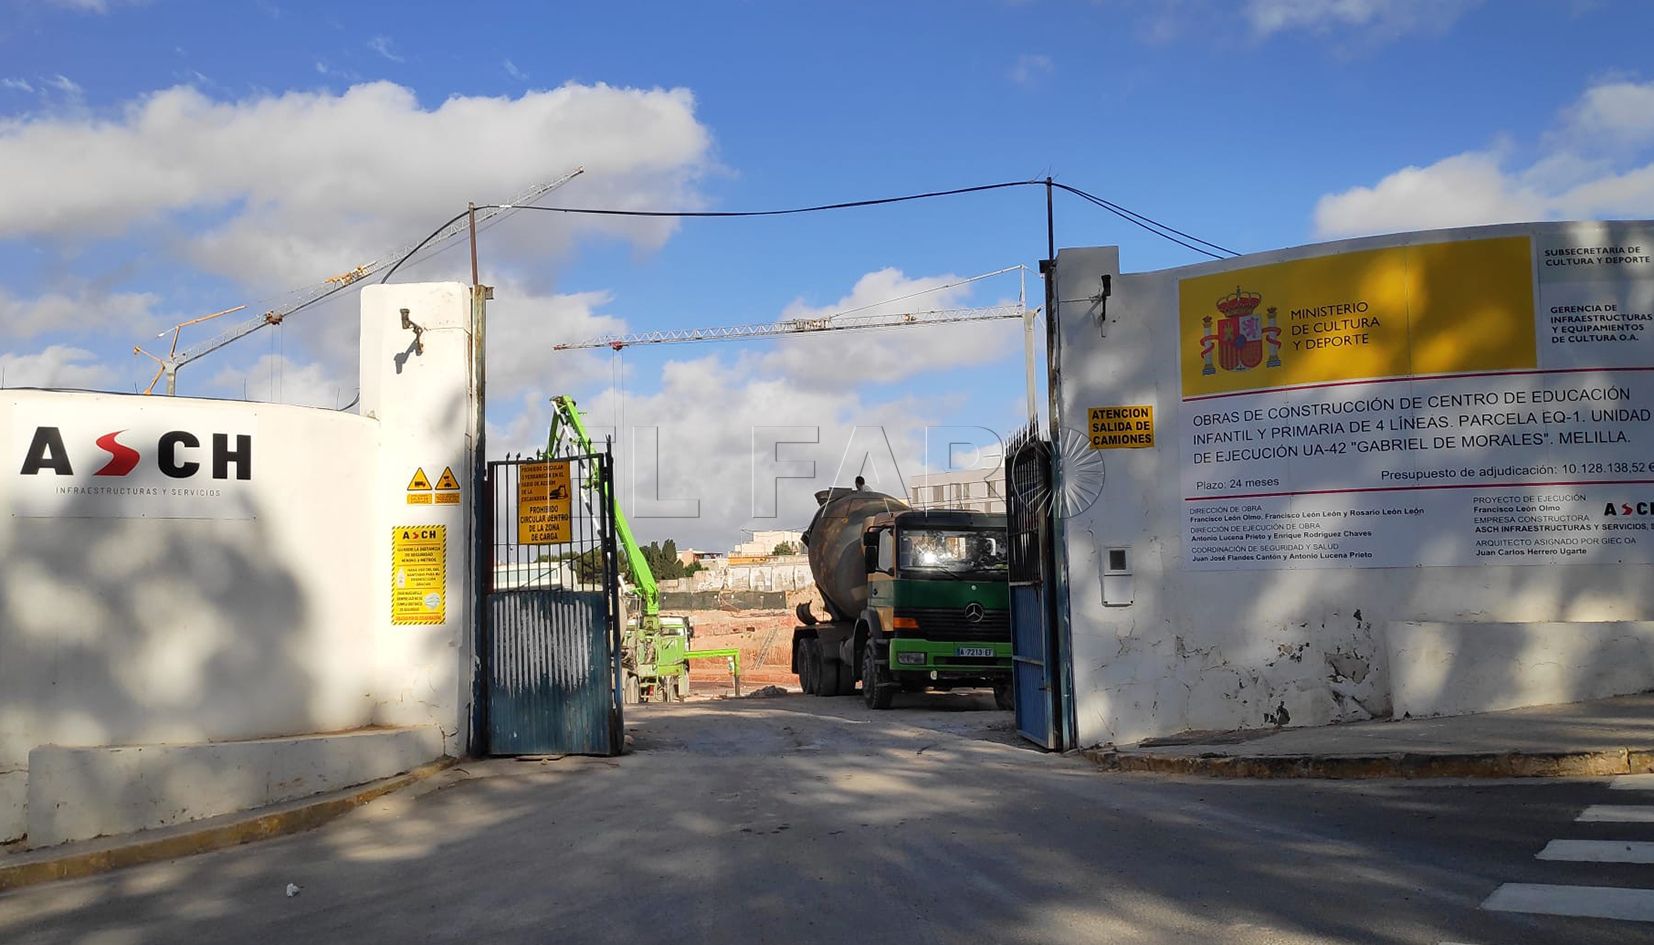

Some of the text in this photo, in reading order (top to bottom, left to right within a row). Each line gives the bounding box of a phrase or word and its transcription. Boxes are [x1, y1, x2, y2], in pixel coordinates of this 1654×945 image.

[1627, 246, 1641, 254] DE
[1545, 257, 1594, 266] CULTURA
[1605, 256, 1650, 264] DEPORTE
[1290, 301, 1368, 320] MINISTERIO
[1550, 304, 1617, 314] GERENCIA DE
[1550, 313, 1653, 324] INFRAESTRUCTURAS
[1291, 316, 1380, 336] DE CULTURA
[1551, 323, 1645, 334] Y EQUIPAMIENTOS
[1292, 333, 1369, 350] Y DEPORTE
[1551, 333, 1639, 344] DE CULTURA O.A.
[1193, 385, 1630, 427] OBRAS DE CONSTRUCCIÓN DE CENTRO DE EDUCACIÓN
[1092, 408, 1149, 420] ATENCION
[1092, 421, 1150, 432] SALIDA DE
[1193, 408, 1651, 445] INFANTIL Y PRIMARIA DE 4 LÍNEAS. PARCELA EQ-1. UNIDAD
[1093, 433, 1152, 445] CAMIONES
[1193, 452, 1212, 464] DE
[1216, 444, 1298, 463] EJECUCIÓN
[1303, 442, 1347, 456] UA-42
[1351, 438, 1428, 453] "GABRIEL
[1433, 436, 1456, 449] DE
[1559, 430, 1631, 444] MELILLA.
[20, 426, 252, 481] ASCH
[1196, 480, 1227, 491] Plazo:
[1229, 479, 1242, 488] 24
[1245, 477, 1280, 487] meses
[1381, 469, 1457, 481] Presupuesto
[1460, 467, 1475, 477] de
[1479, 465, 1557, 479] adjudicación:
[1562, 462, 1646, 474] 10.128.138,52
[55, 486, 221, 497] INFRAESTRUCTURAS Y SERVICIOS
[1473, 496, 1521, 504] PROYECTO
[1537, 494, 1586, 502] EJECUCIÓN
[529, 505, 558, 513] PROHIBIDO
[1189, 506, 1228, 515] DIRECCIÓN
[1264, 512, 1300, 520] Francisco
[1404, 507, 1424, 515] León
[520, 514, 568, 523] CIRCULAR DENTRO
[1474, 514, 1590, 524] EMPRESA CONSTRUCTORA
[537, 524, 544, 532] LA
[545, 523, 560, 531] ZONA
[1242, 523, 1284, 532] EJECUCIÓN
[1298, 522, 1321, 530] OBRA
[1501, 524, 1592, 533] INFRAESTRUCTURAS
[402, 530, 436, 540] ASCH
[531, 532, 558, 541] DE CARGA
[1273, 532, 1302, 540] Enrique
[1260, 543, 1304, 552] SEGURIDAD
[1475, 539, 1532, 547] ARQUITECTO
[1534, 538, 1578, 546] ASIGNADO
[1559, 548, 1587, 556] Ugarte
